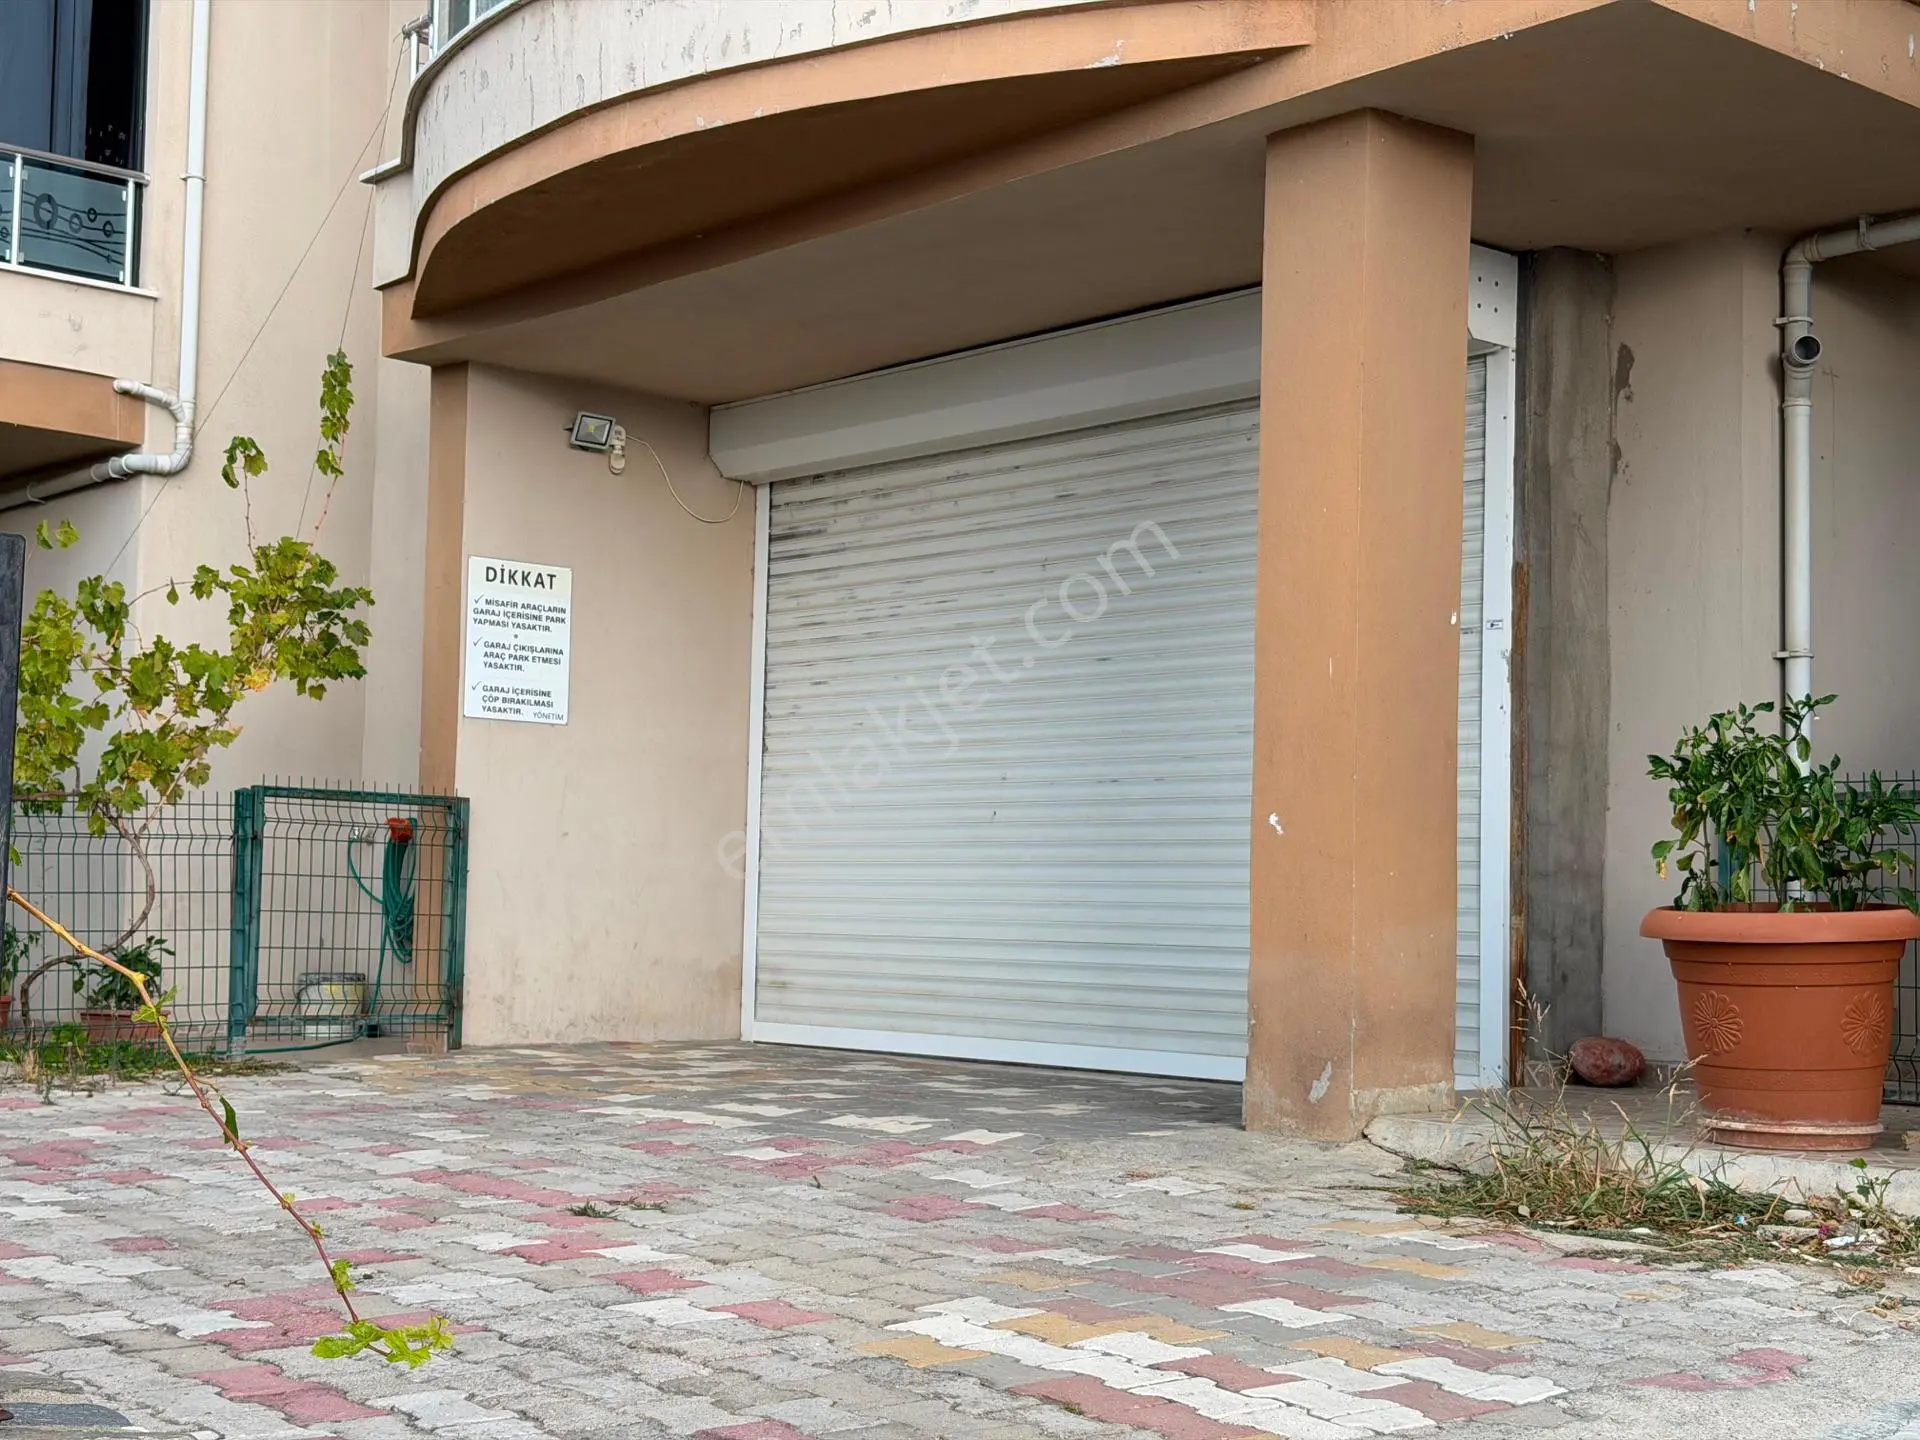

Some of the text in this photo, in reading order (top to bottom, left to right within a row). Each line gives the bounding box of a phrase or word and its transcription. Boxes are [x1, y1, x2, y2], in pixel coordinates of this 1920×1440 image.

[485, 564, 557, 590] DİKKAT
[485, 598, 566, 614] MİSAFİR ARAÇLARIN
[473, 607, 566, 624] GARAJ İÇERİSİNE PARK
[472, 618, 553, 632] YAPMASI YASAKTIR.
[483, 641, 564, 656] GARAJ ÇIKIŞLARINA
[483, 651, 506, 661] ARAÇ
[508, 653, 530, 662] PARK
[483, 661, 525, 672] YASAKTIR.
[482, 685, 552, 698] GARAJ İÇERİSİNE
[482, 694, 553, 708] ÇÖP BIRAKILMASI
[482, 705, 524, 716] YASAKTIR.
[533, 711, 564, 721] YÖNETİM
